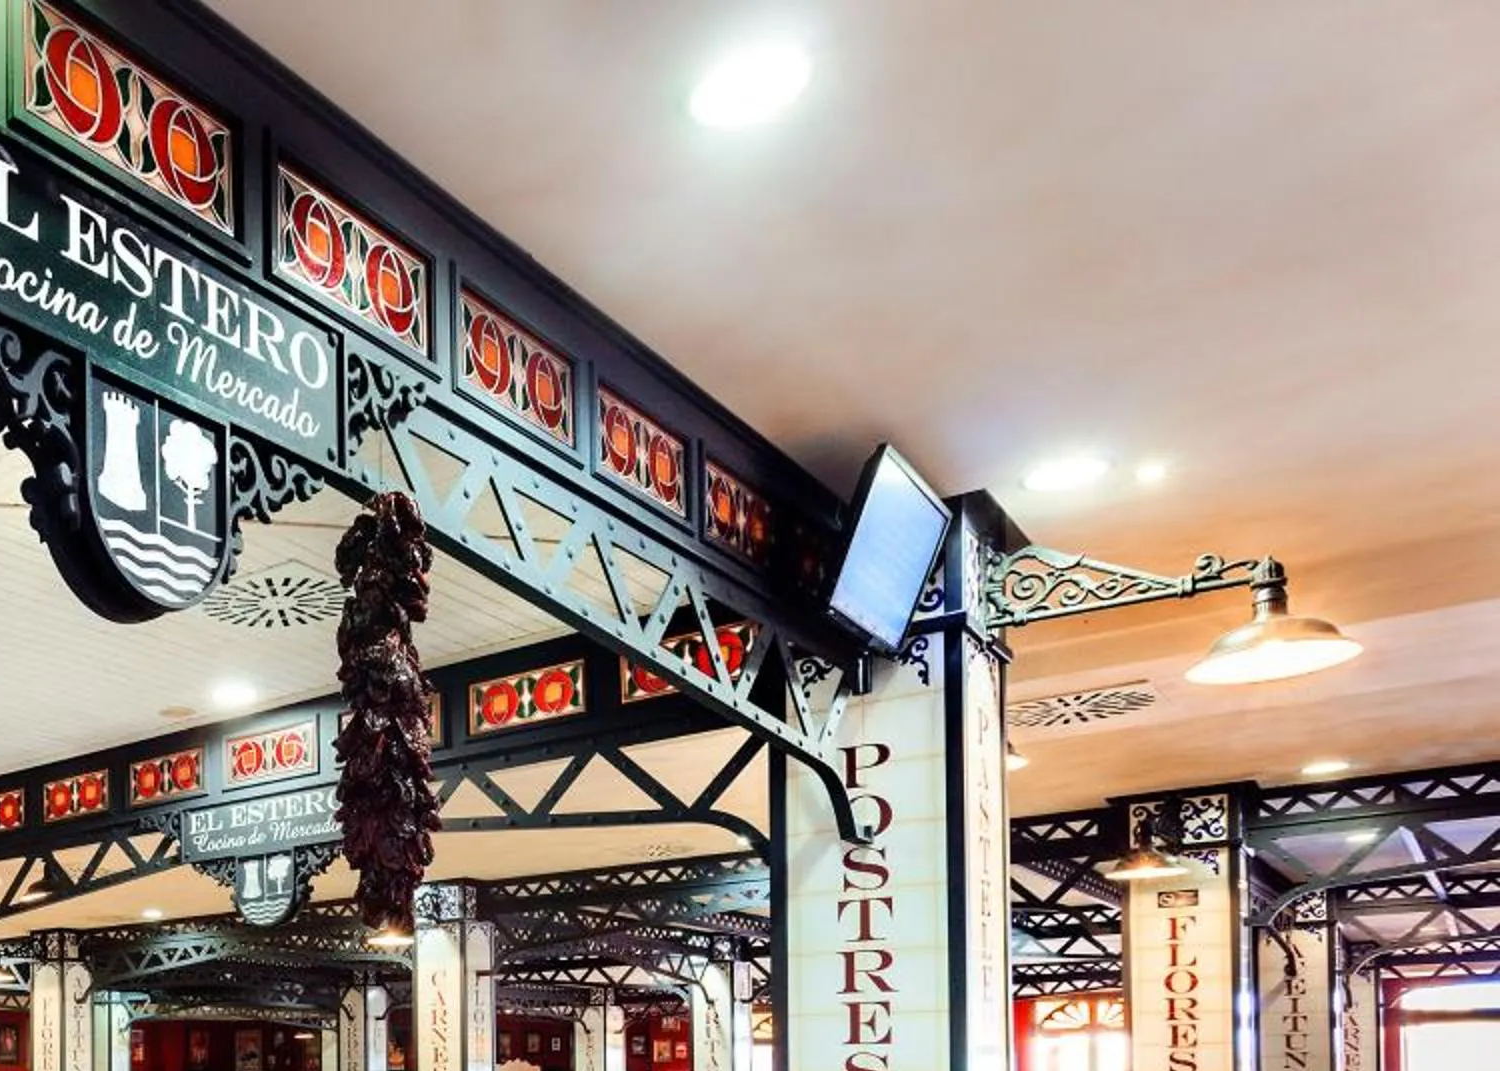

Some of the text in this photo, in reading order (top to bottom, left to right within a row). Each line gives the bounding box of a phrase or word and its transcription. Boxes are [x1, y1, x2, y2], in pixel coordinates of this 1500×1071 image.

[59, 194, 329, 389] ESTERO
[112, 308, 160, 359] de
[168, 324, 319, 438] Mercado
[189, 788, 342, 835] EL ESTERO
[193, 815, 343, 853] Cocina de Mercado
